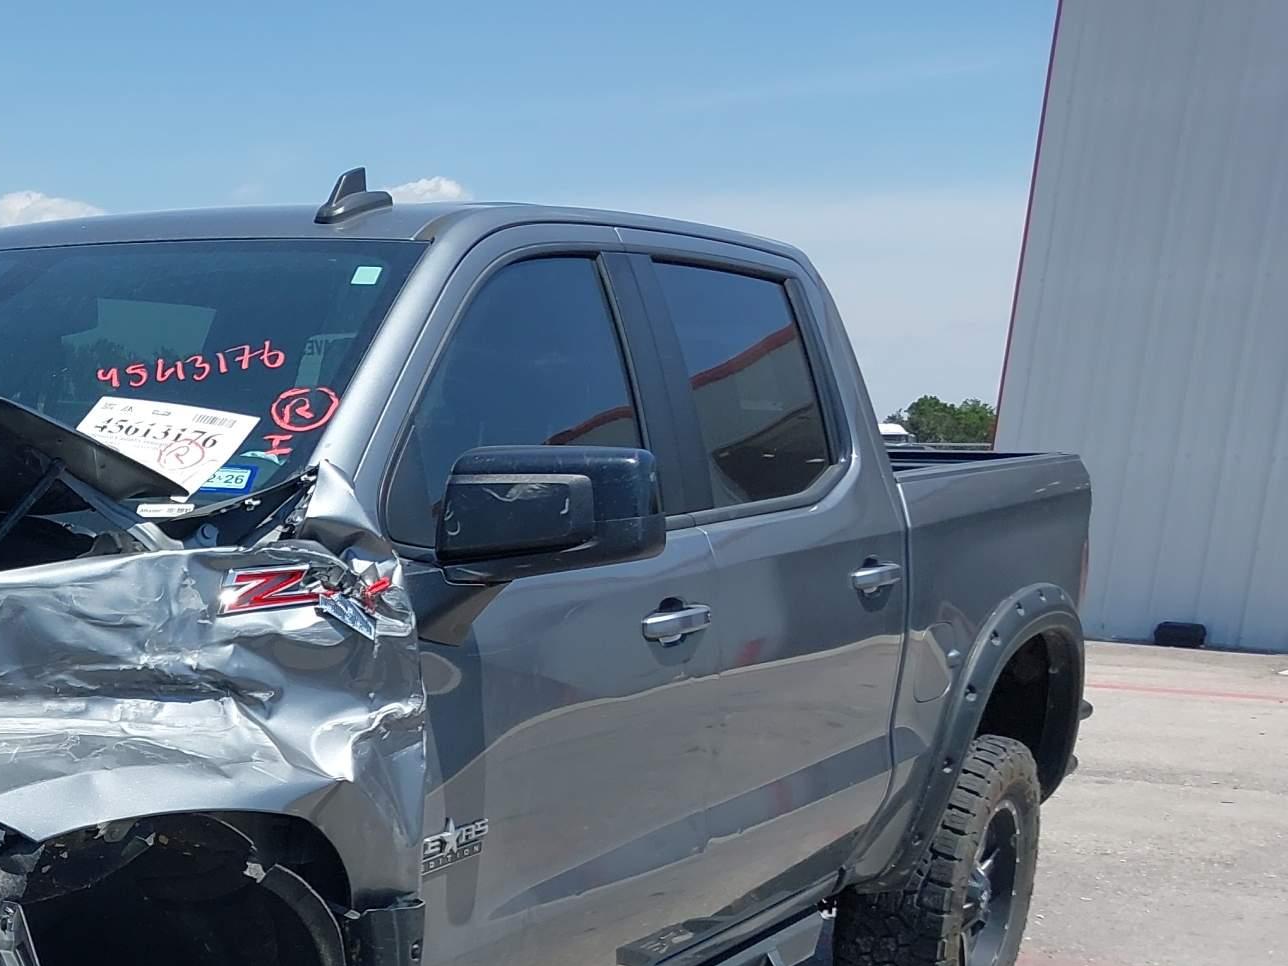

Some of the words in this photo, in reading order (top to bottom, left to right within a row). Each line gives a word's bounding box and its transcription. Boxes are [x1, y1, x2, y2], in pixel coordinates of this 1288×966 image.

[94, 417, 224, 449] 45613176
[223, 474, 245, 485] 26
[421, 842, 481, 874] DITION
